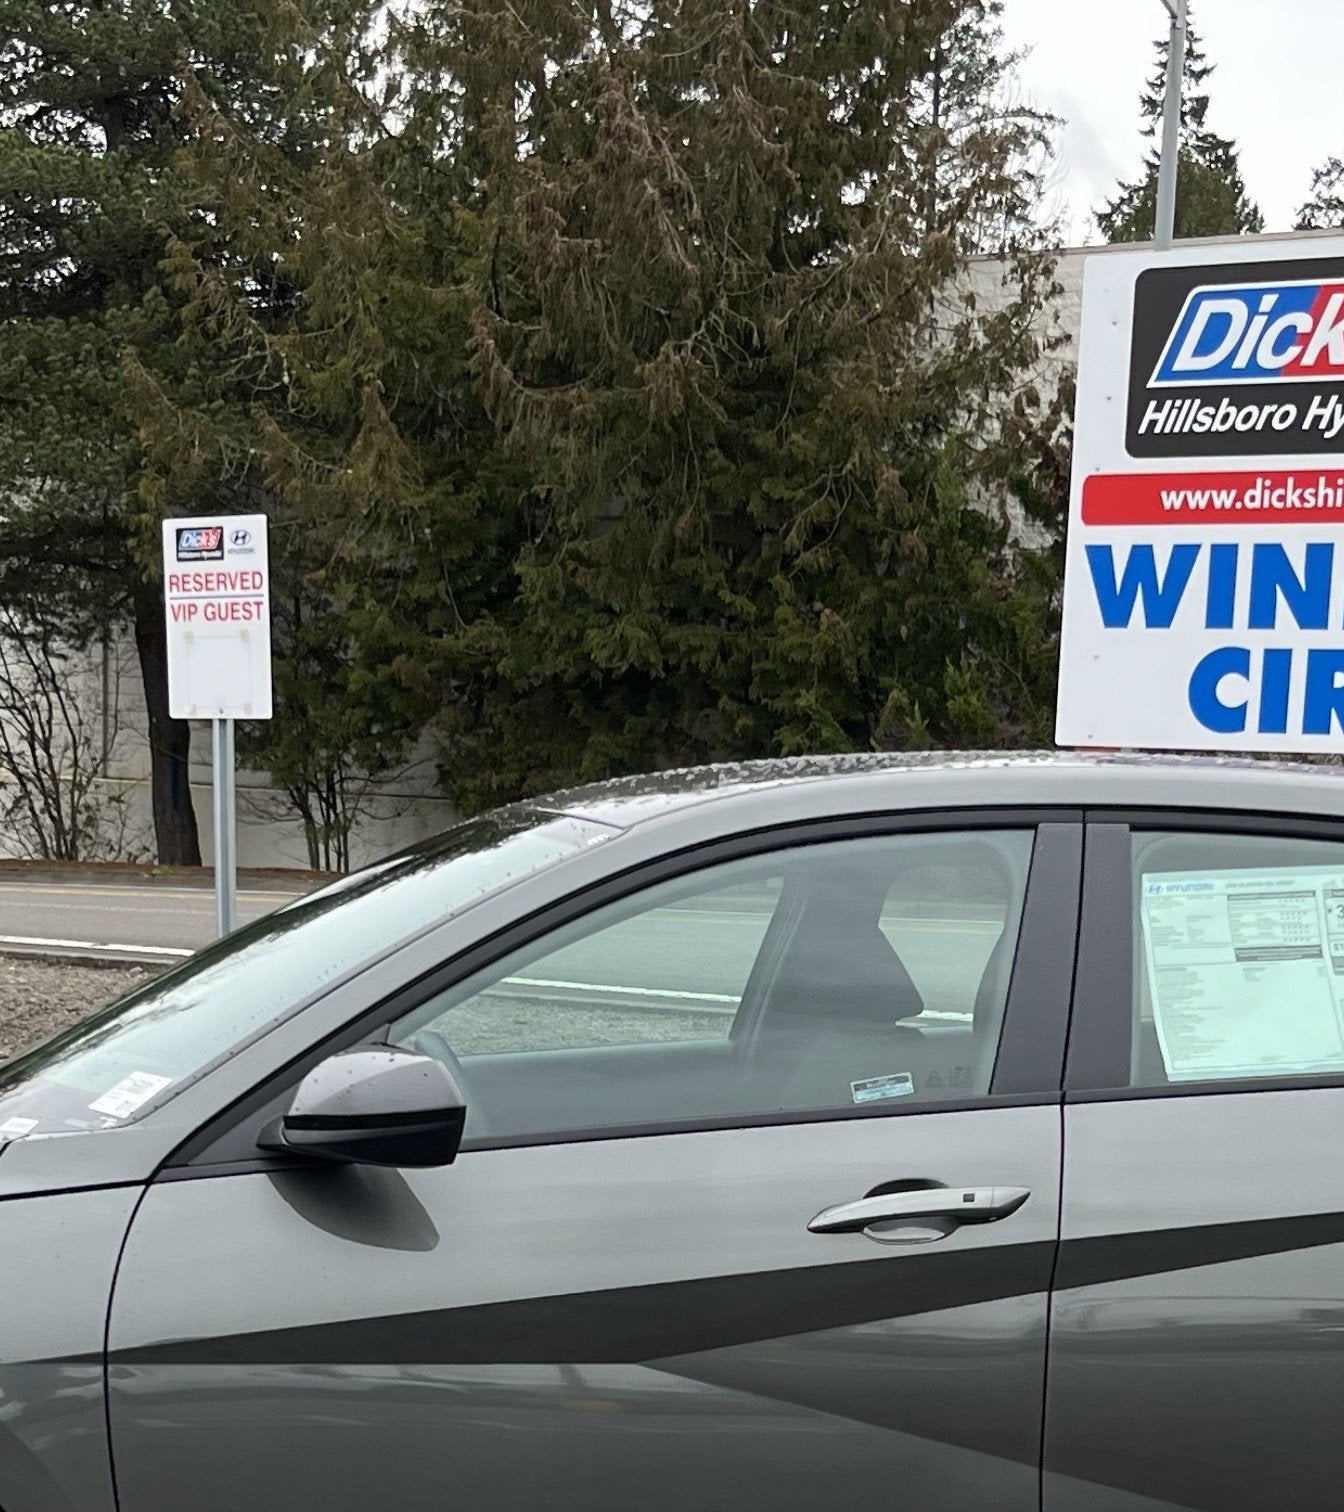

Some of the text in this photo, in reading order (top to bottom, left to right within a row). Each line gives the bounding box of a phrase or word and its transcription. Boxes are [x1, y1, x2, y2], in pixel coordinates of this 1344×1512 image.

[1137, 399, 1302, 434] Hillsboro
[169, 571, 263, 593] RESERVED
[171, 601, 264, 622] VIP GUEST
